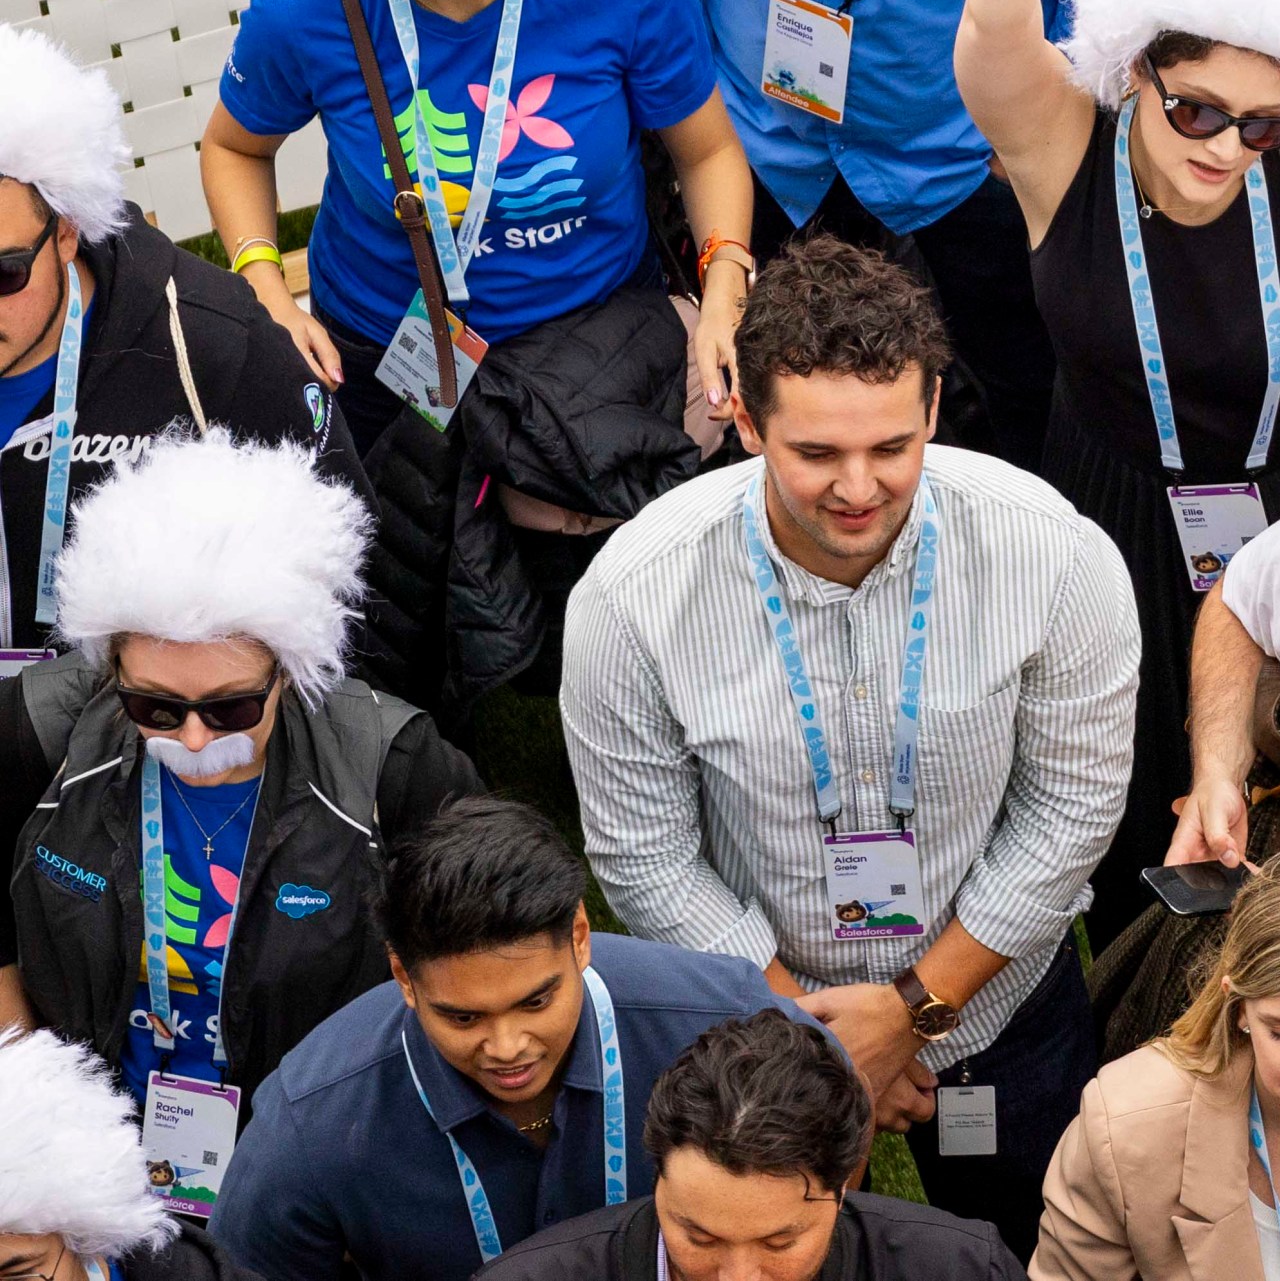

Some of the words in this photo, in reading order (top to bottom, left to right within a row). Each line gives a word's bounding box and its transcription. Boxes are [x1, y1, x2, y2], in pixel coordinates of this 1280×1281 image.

[777, 13, 813, 33] Enrique
[768, 86, 810, 108] Attendee
[1182, 508, 1204, 518] Ellie
[834, 856, 867, 864] Aidan
[37, 845, 106, 892] CUSTOMER
[282, 895, 326, 907] salesforce
[840, 927, 893, 937] Salesforce
[156, 1101, 194, 1117] Rachel
